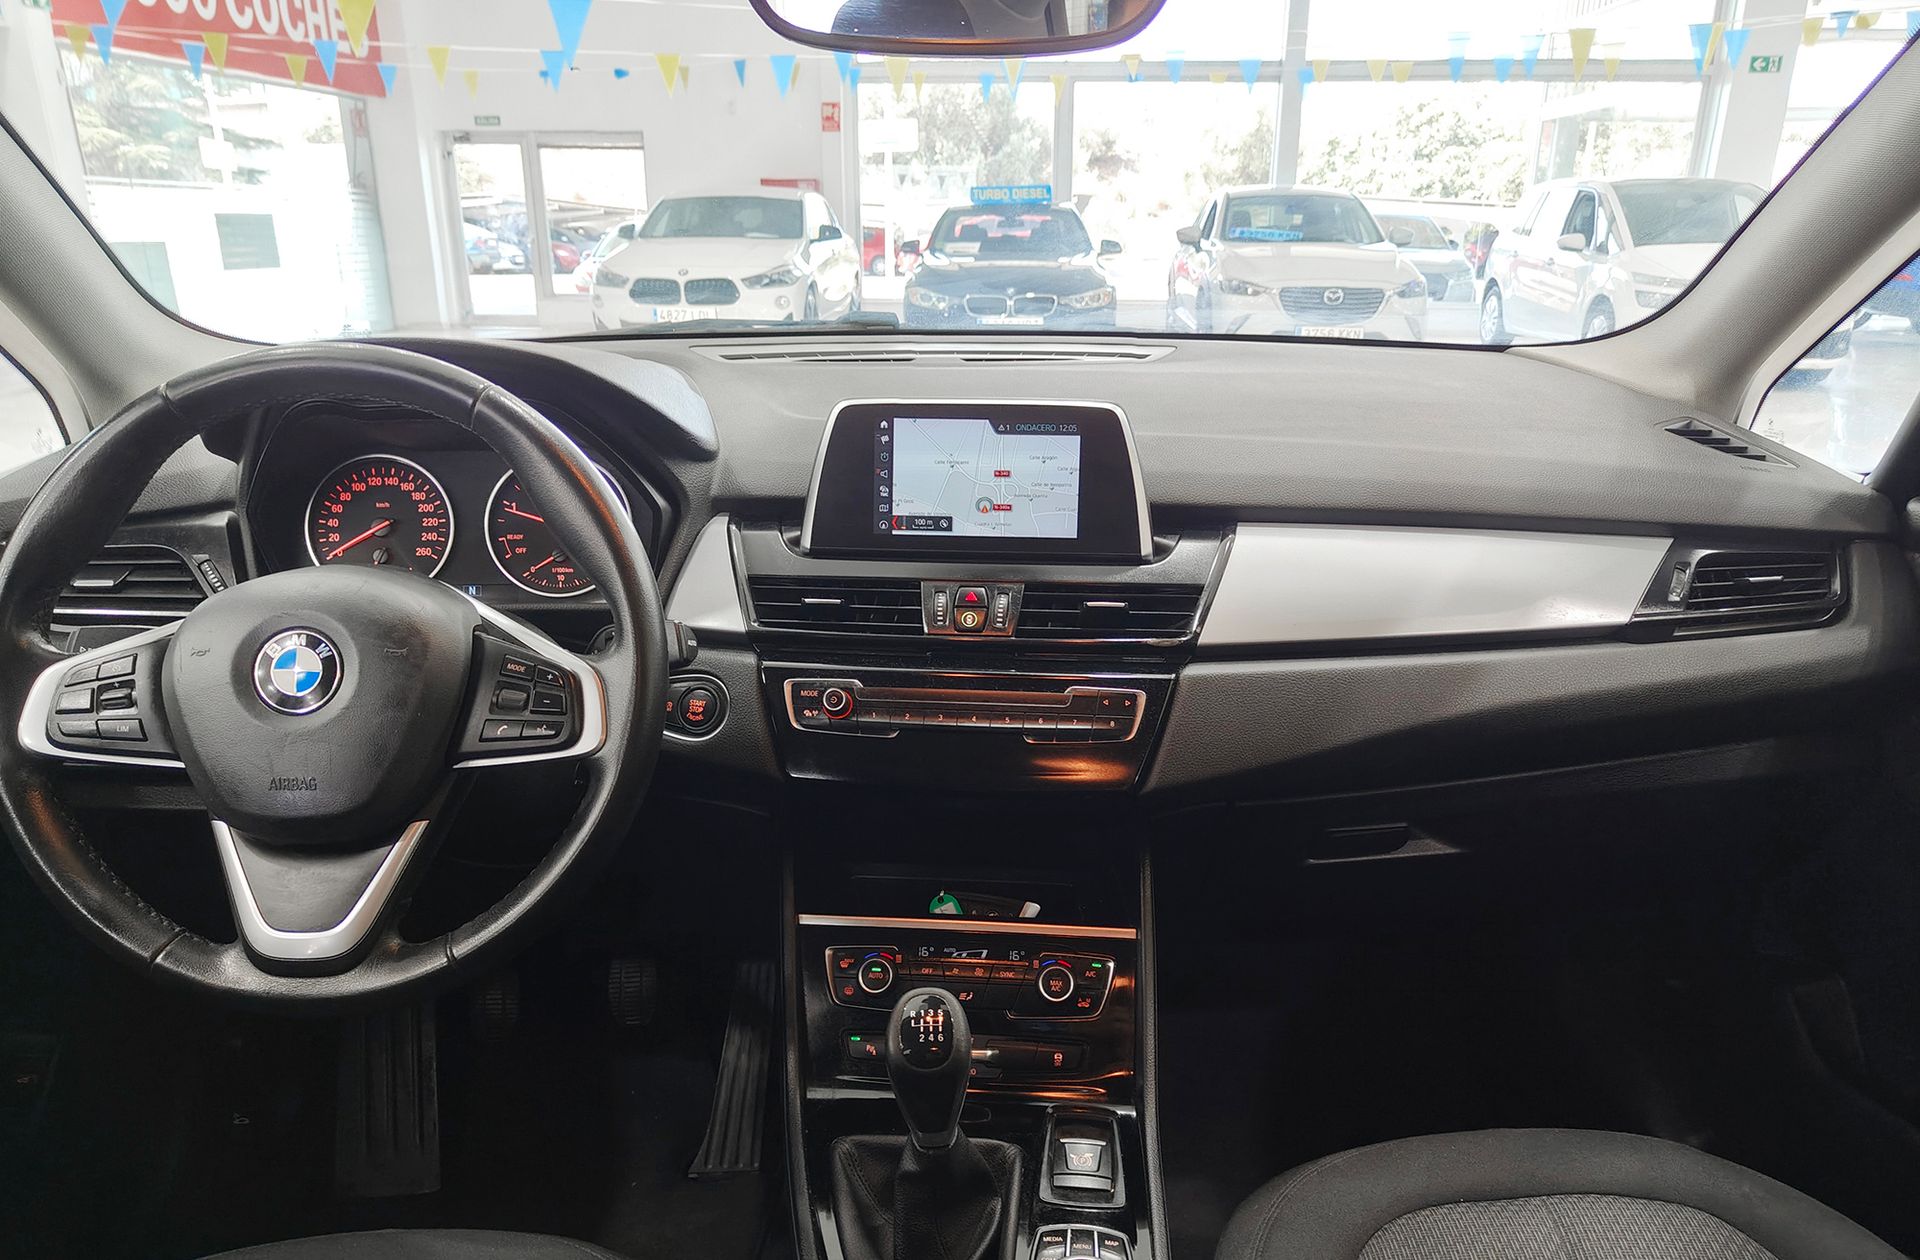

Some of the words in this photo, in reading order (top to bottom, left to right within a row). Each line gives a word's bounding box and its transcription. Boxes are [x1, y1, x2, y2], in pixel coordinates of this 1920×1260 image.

[974, 189, 1008, 200] TURBO
[1012, 188, 1049, 199] DIESEL
[1016, 423, 1056, 432] ONDACERO
[1059, 424, 1078, 432] 12:05
[367, 477, 382, 486] 120
[384, 477, 399, 486] 140
[351, 483, 366, 491] 100
[400, 483, 415, 491] 160
[340, 492, 352, 501] 80
[411, 492, 426, 501] 180
[331, 504, 343, 513] 60
[418, 504, 434, 512] 200
[327, 519, 339, 528] 40
[422, 518, 438, 526] 220
[328, 533, 340, 542] 20
[421, 533, 437, 541] 240
[415, 547, 432, 556] 260
[468, 586, 476, 595] N
[265, 634, 332, 660] BMW
[506, 662, 527, 673] MODE
[800, 690, 818, 698] MODE
[268, 777, 318, 791] AIRBAG
[1085, 970, 1096, 978] A/C
[910, 1010, 916, 1018] R
[920, 1009, 924, 1017] 1
[919, 1034, 925, 1042] 2
[928, 1034, 934, 1042] 4
[937, 1034, 944, 1042] 6
[1104, 1239, 1119, 1247] MAP
